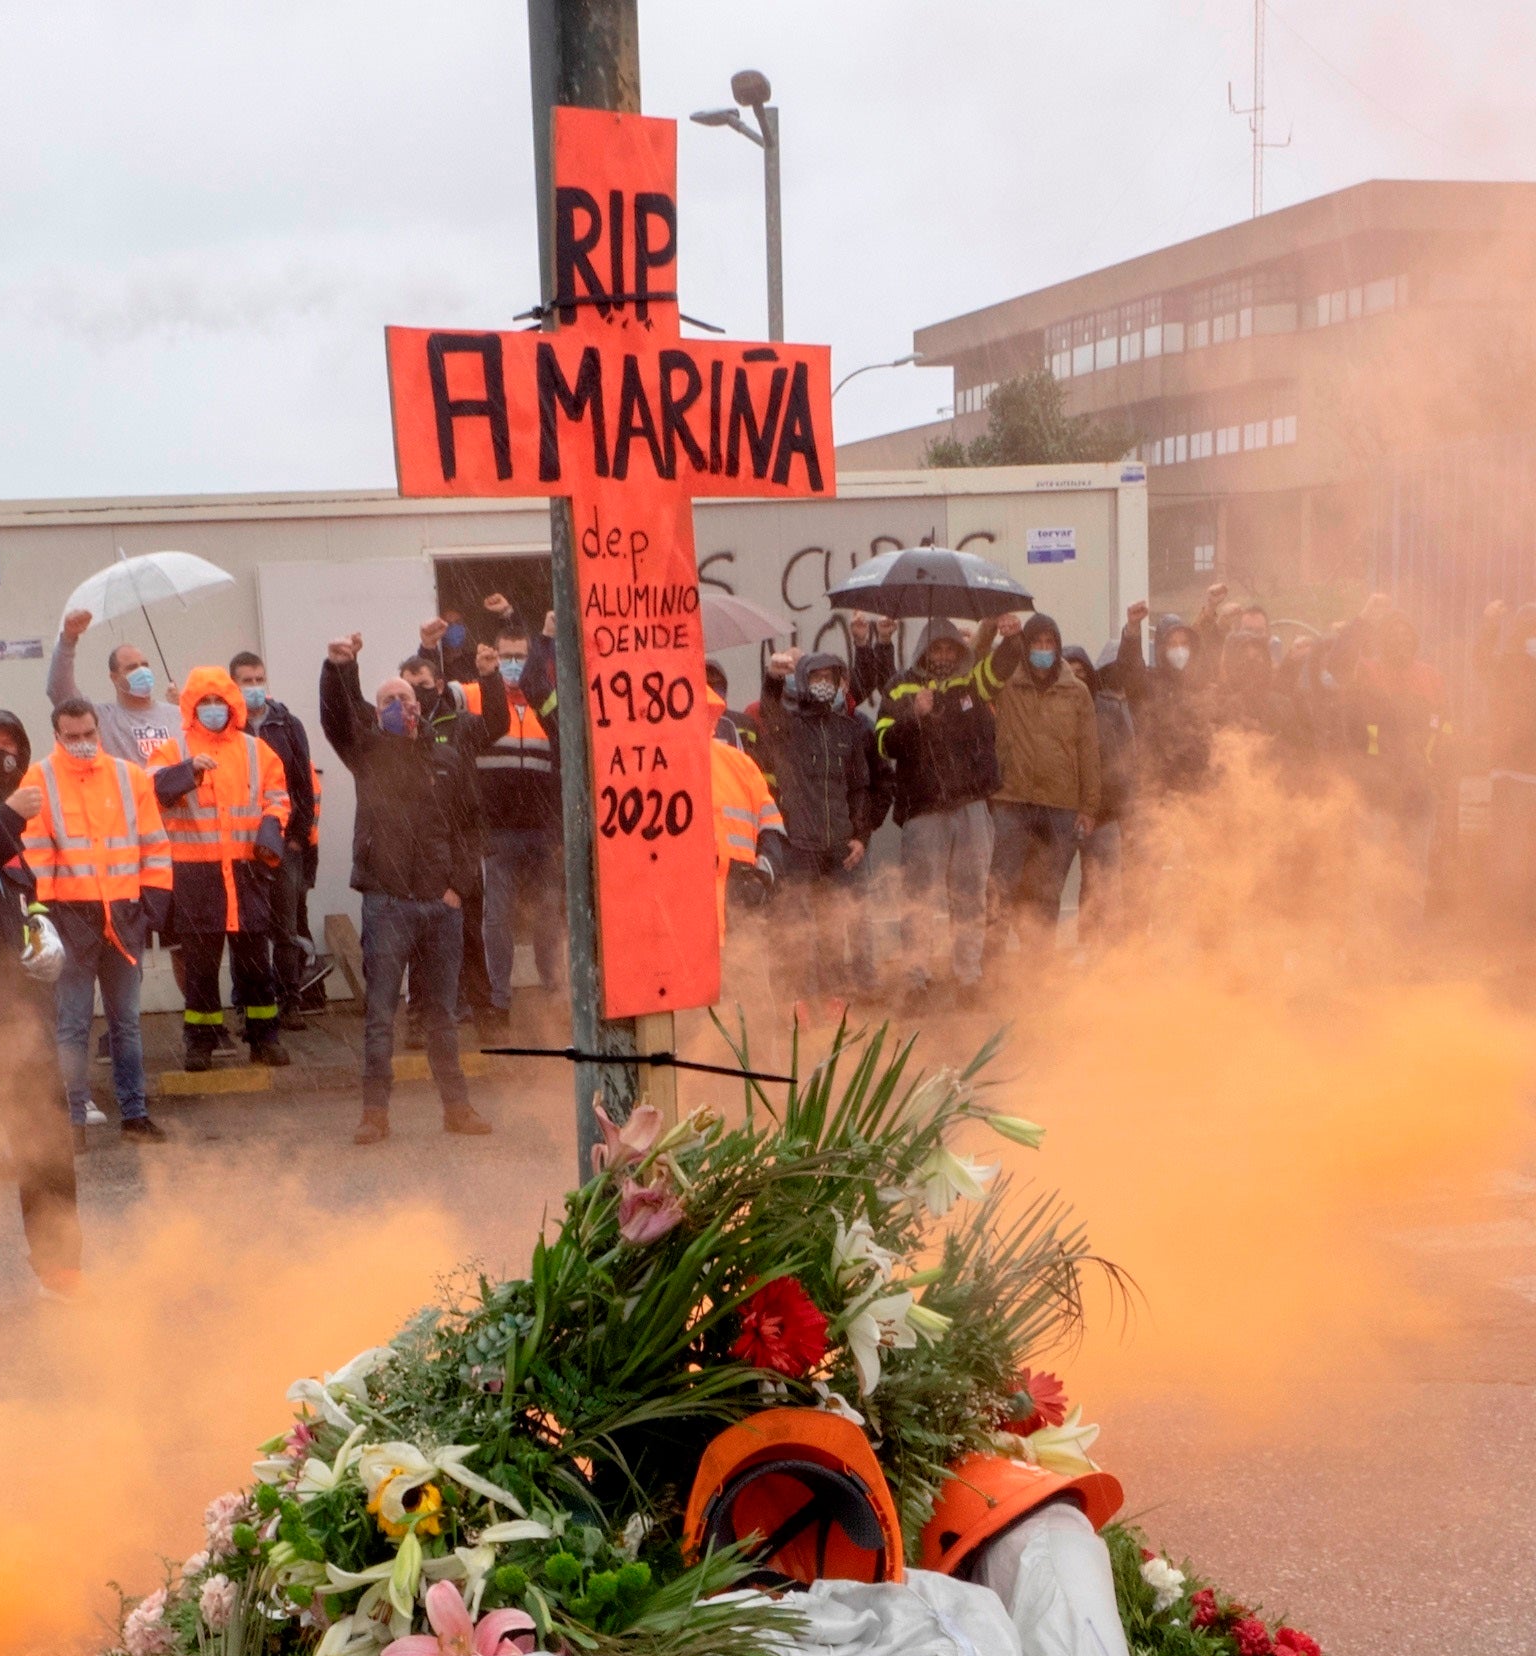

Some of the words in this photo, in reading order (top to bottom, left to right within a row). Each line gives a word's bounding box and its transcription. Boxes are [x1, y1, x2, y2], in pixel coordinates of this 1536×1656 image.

[556, 187, 677, 325] RIP
[427, 333, 512, 481] A
[537, 342, 823, 491] MARIÑA
[585, 582, 699, 619] ALUMINIO
[591, 671, 694, 728] 1980
[610, 745, 668, 774] ATA
[599, 786, 693, 841] 2020
